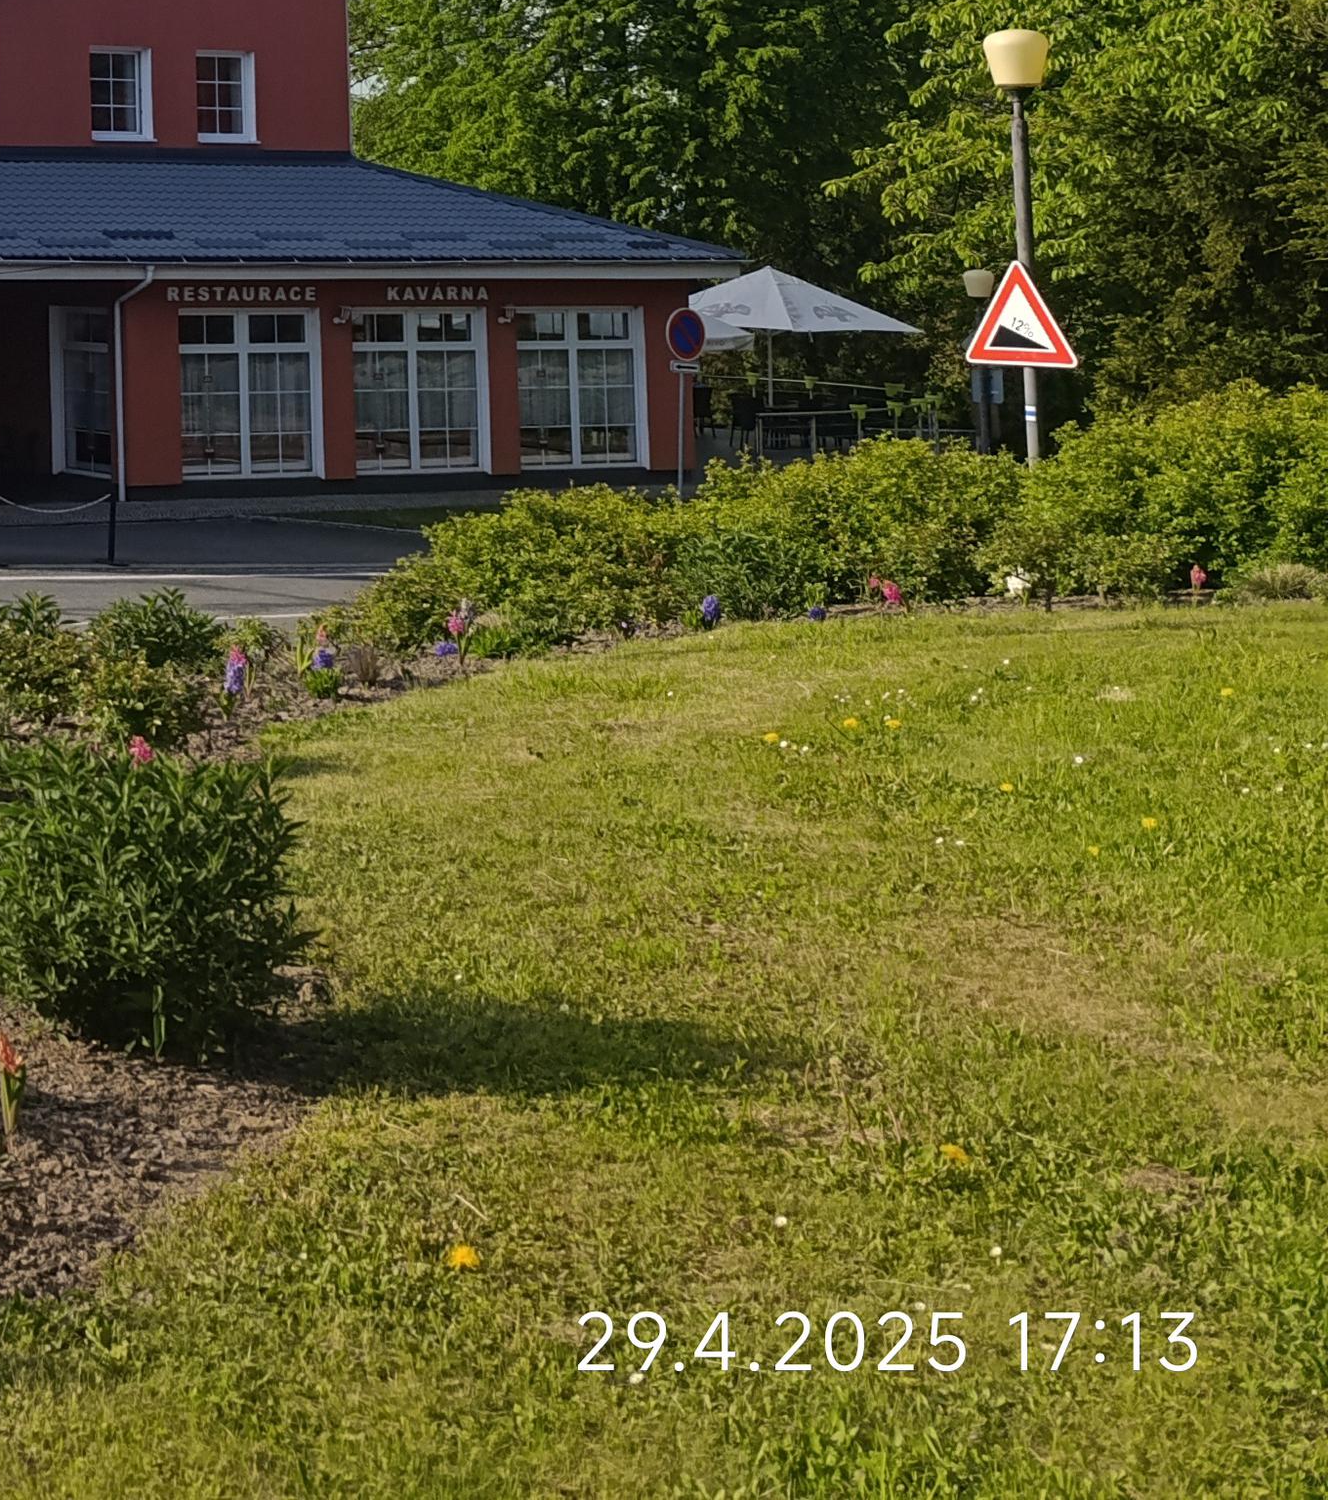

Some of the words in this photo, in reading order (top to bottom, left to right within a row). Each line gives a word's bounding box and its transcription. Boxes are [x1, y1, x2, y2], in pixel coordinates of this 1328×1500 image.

[167, 286, 317, 301] RESTAURACE
[386, 282, 490, 301] KAVÁRNA
[1011, 316, 1034, 338] 12%
